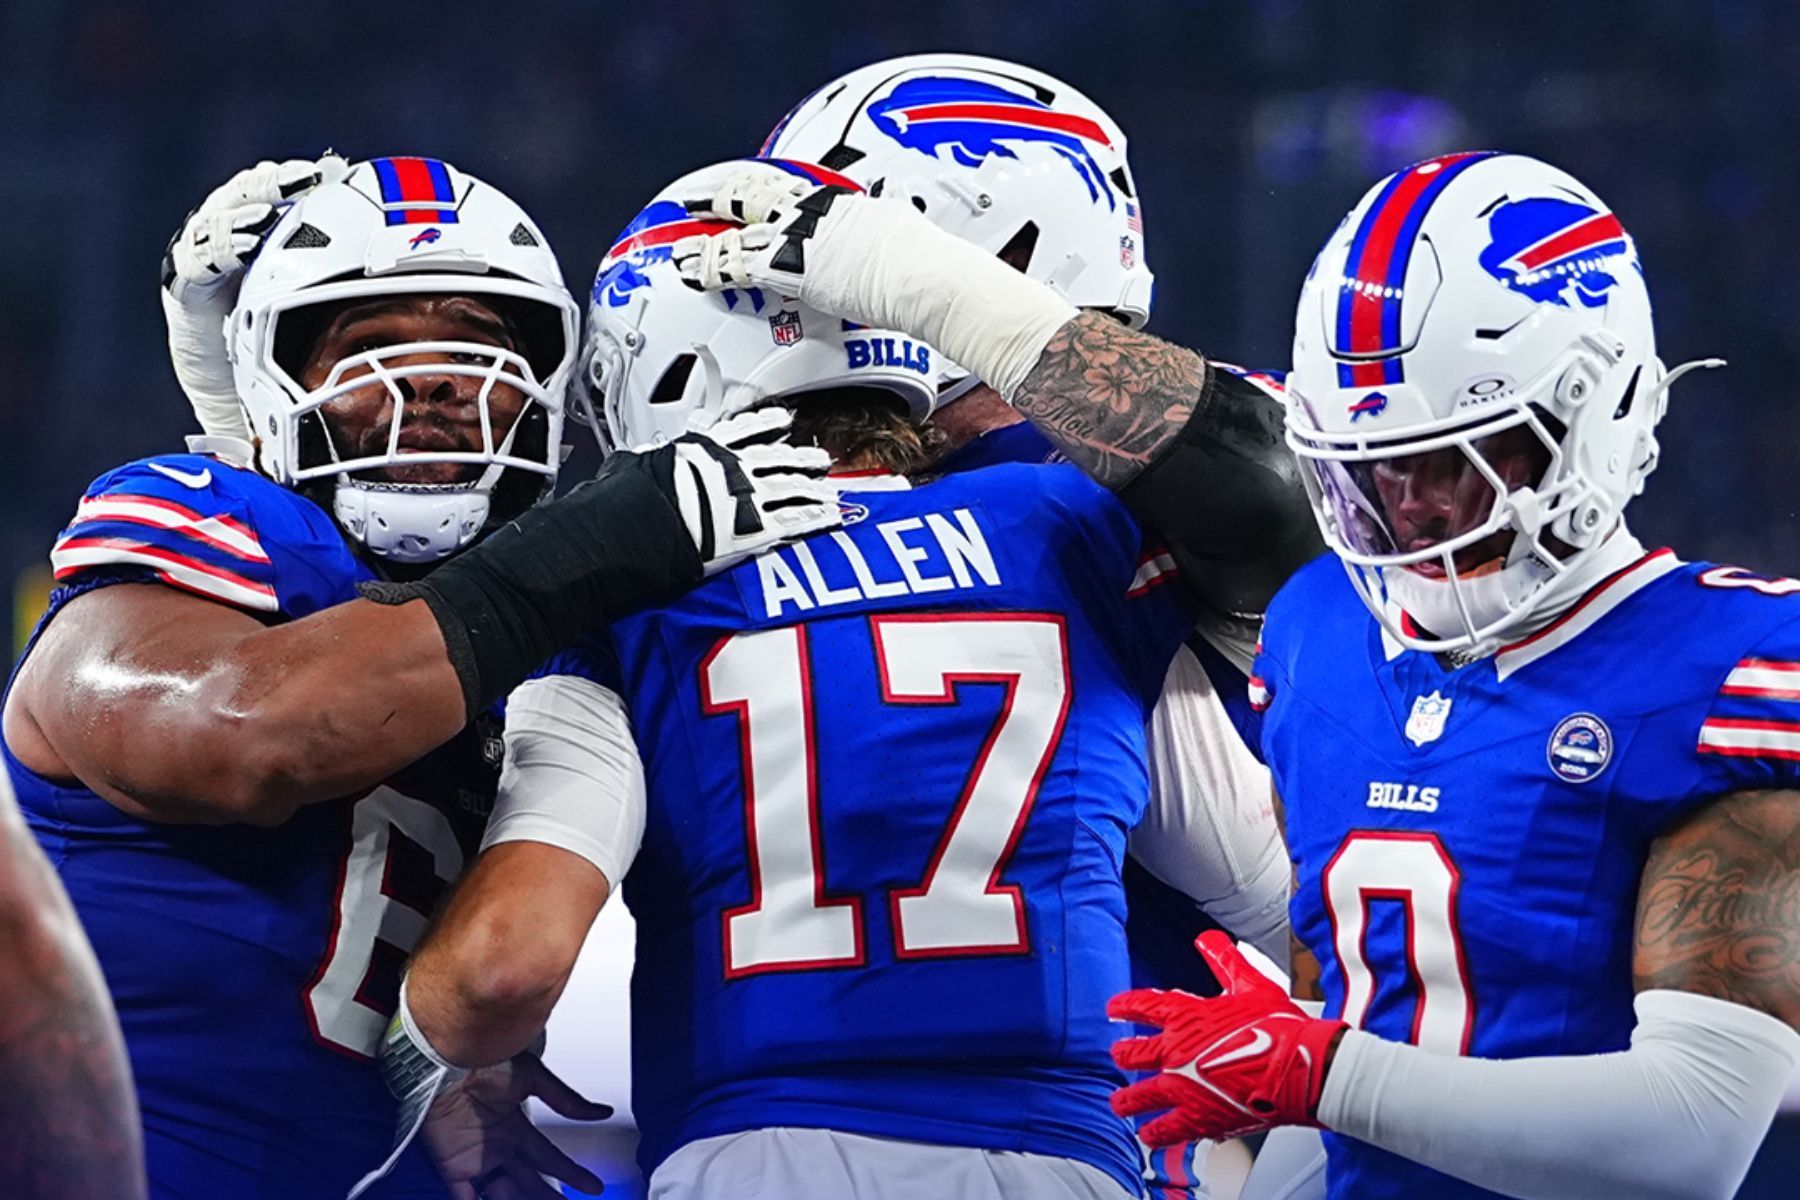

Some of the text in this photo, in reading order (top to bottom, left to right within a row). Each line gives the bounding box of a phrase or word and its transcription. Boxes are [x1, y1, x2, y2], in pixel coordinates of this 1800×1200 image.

[773, 324, 802, 343] NFL
[844, 338, 930, 375] BILLS
[1460, 388, 1514, 408] OAKLEY
[755, 508, 1002, 618] ALLEN
[699, 612, 1073, 981] 17
[1366, 781, 1442, 813] BILLS
[1321, 829, 1477, 1058] 0
